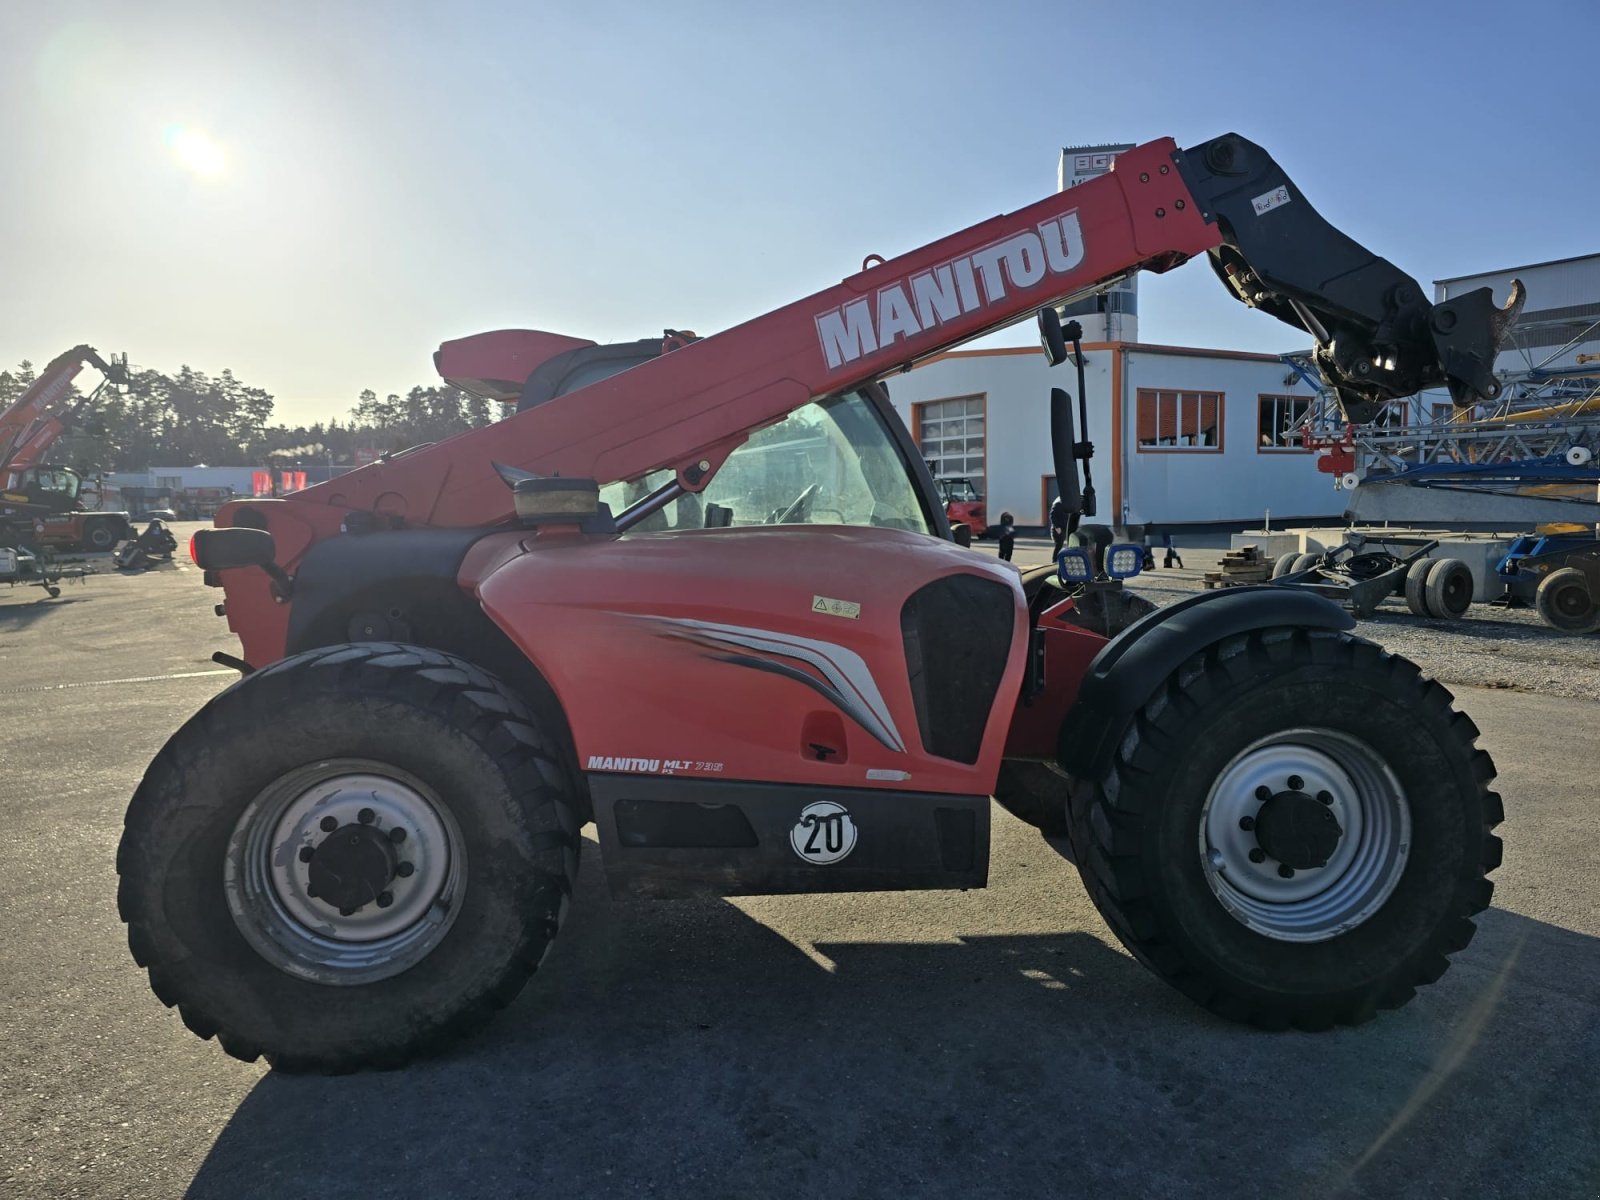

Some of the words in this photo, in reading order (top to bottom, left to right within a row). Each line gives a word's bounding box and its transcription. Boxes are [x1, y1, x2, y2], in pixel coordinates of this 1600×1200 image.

[1074, 154, 1115, 170] BG
[815, 209, 1085, 371] MANITOU
[587, 755, 660, 772] MANITOU
[663, 760, 692, 770] MLT
[695, 761, 723, 772] 735
[803, 813, 843, 854] 20
